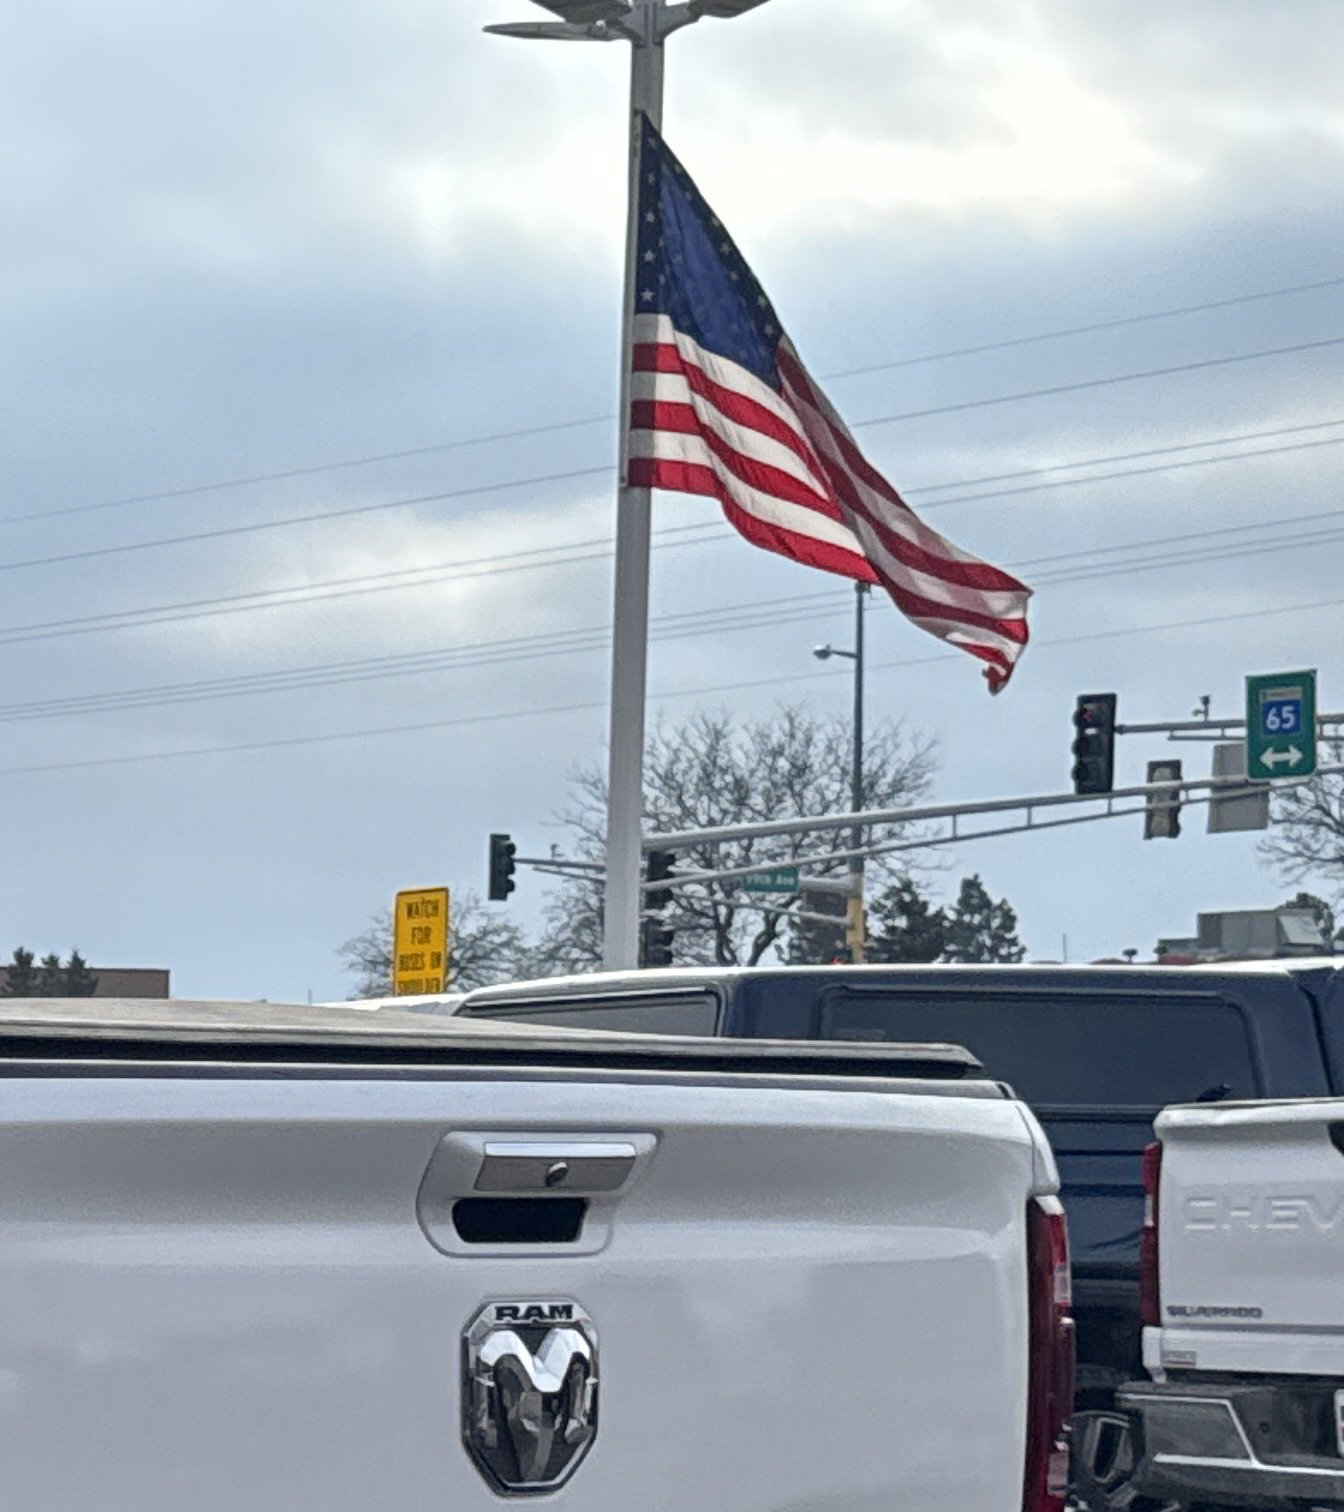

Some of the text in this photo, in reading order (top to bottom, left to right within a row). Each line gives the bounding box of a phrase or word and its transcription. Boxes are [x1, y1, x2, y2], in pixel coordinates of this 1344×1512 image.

[1266, 705, 1295, 731] 65
[406, 899, 439, 919] WATCH
[411, 926, 432, 945] FOR
[494, 1304, 574, 1321] RAM
